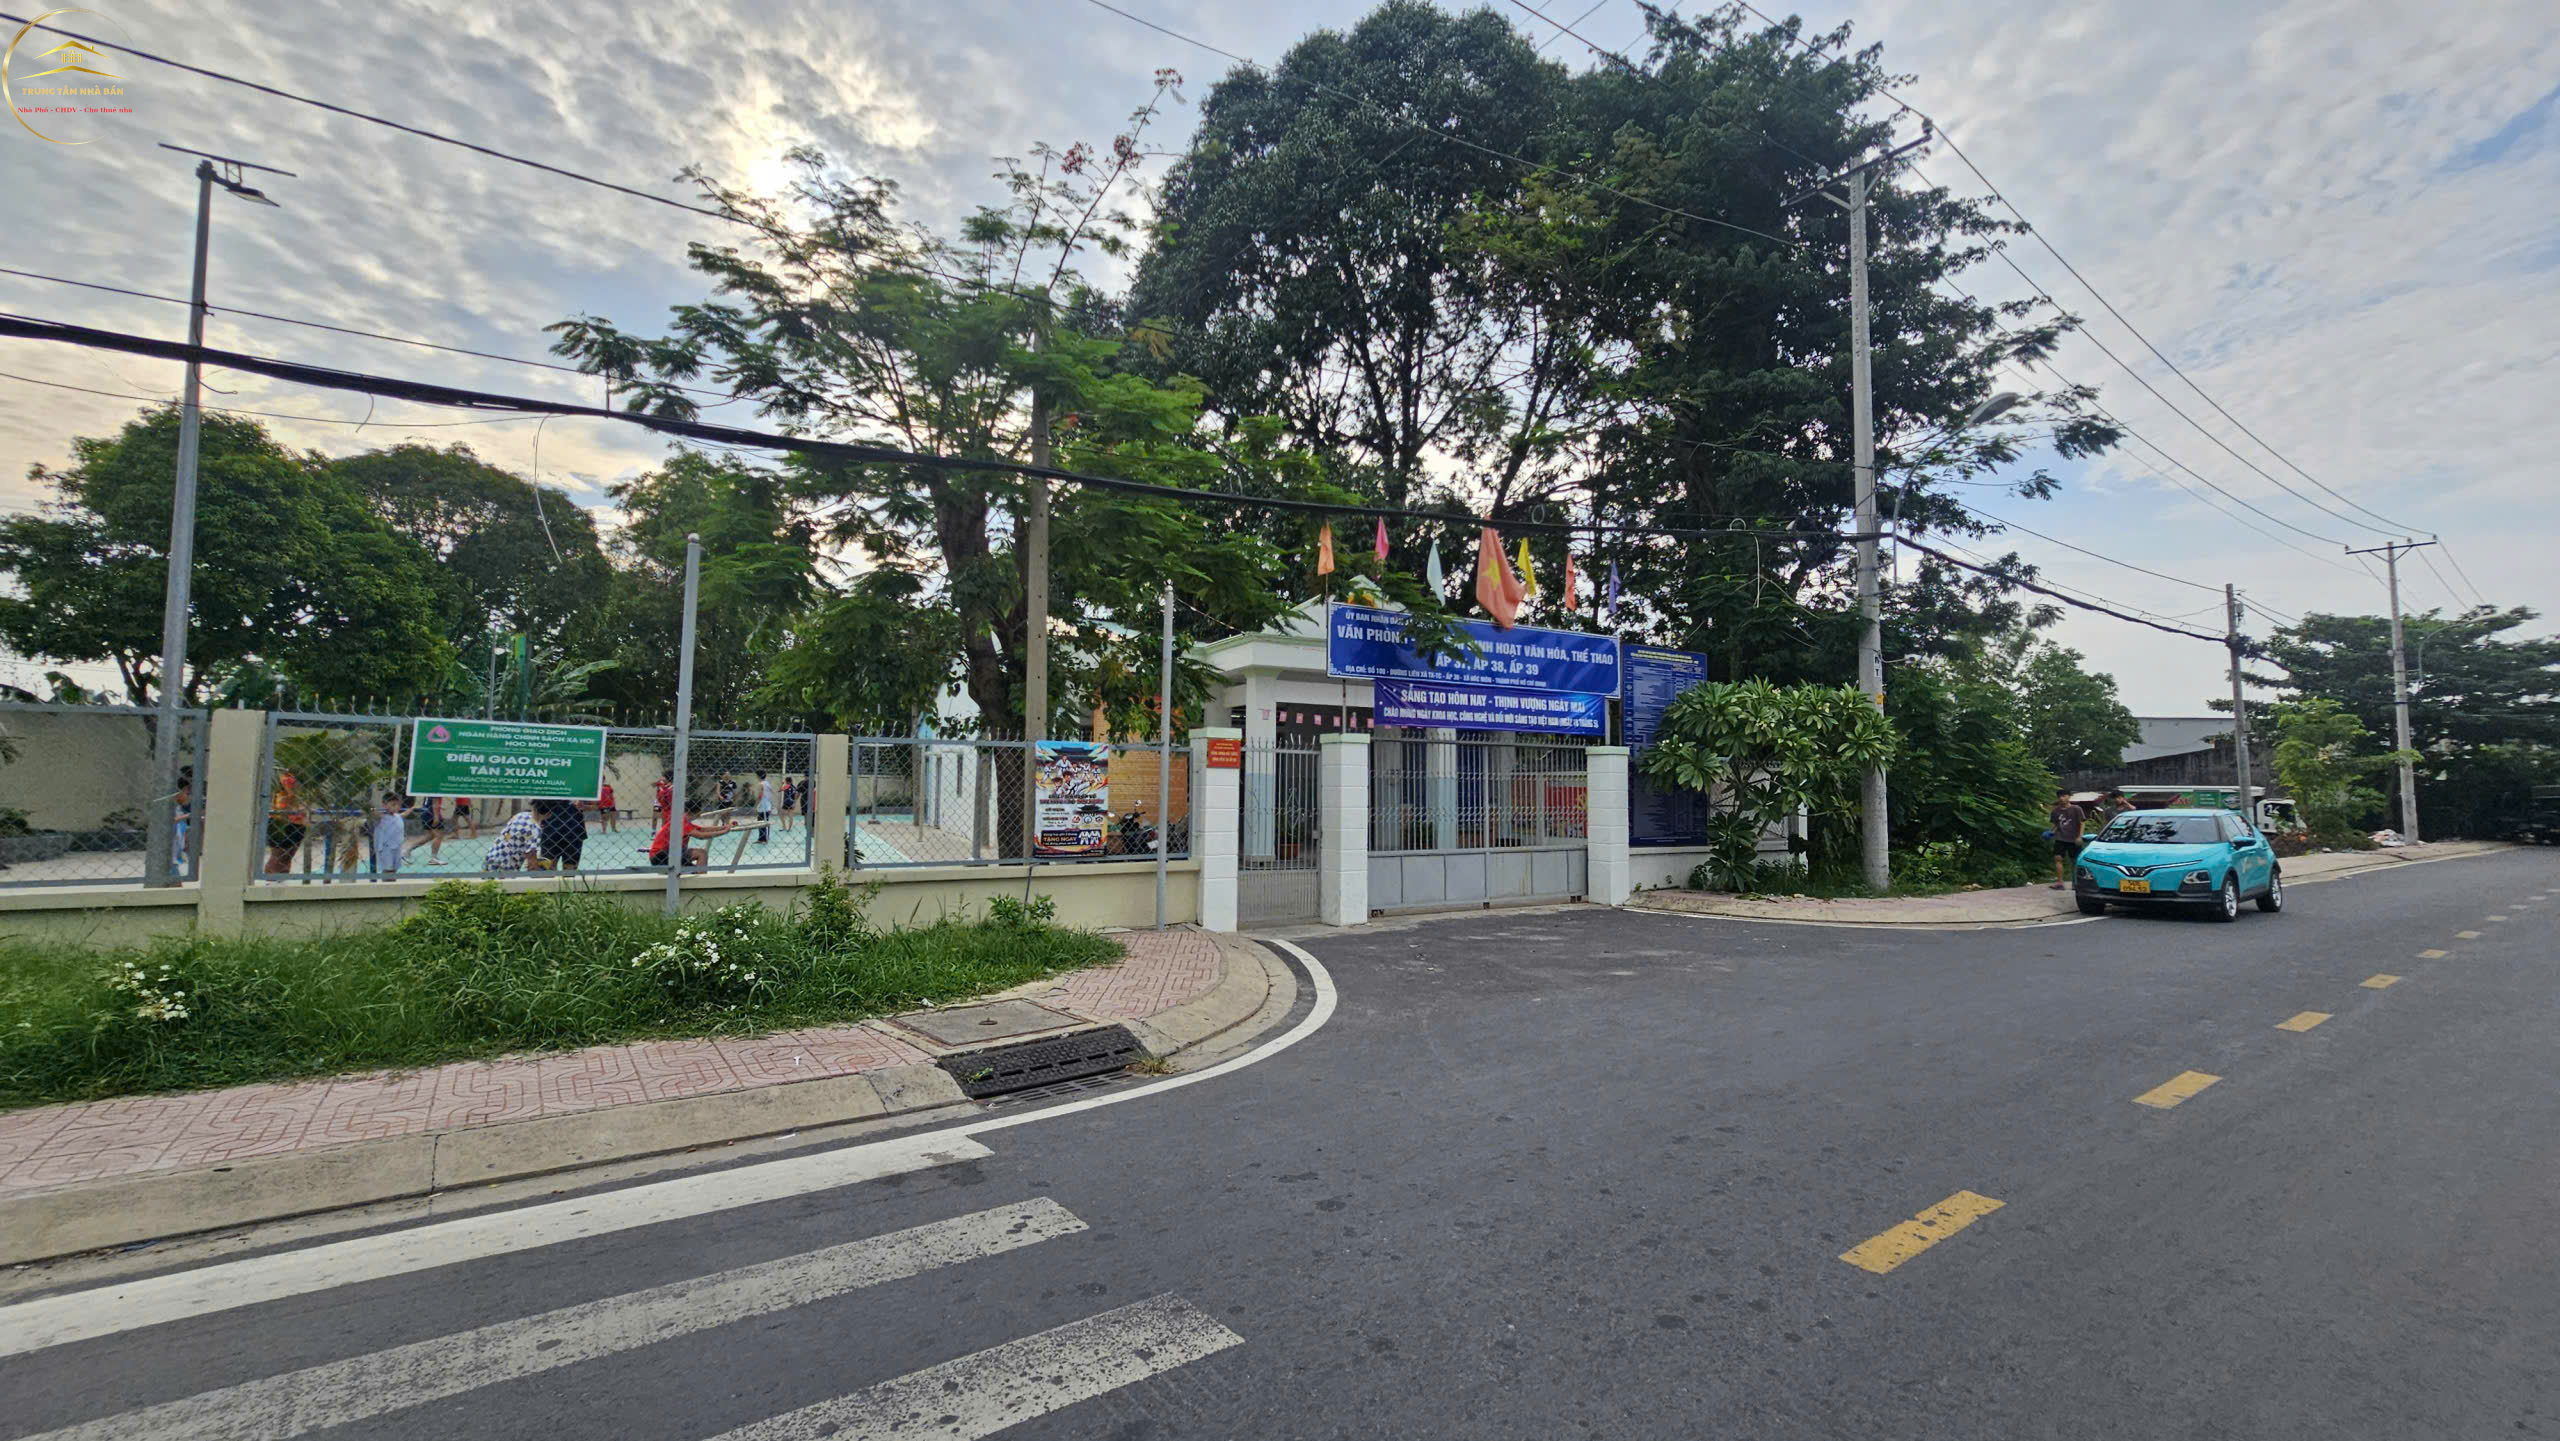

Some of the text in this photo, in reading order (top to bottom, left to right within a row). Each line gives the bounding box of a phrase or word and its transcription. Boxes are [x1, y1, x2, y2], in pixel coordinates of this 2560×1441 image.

[1355, 612, 1370, 621] BAN
[1371, 614, 1388, 624] NHÂN
[1337, 623, 1363, 640] VĂN
[1495, 641, 1522, 658] HOẠT
[1524, 644, 1545, 659] VĂN
[1546, 646, 1570, 662] HÓA,
[1590, 652, 1614, 665] THAO
[1490, 660, 1507, 674] 38,
[1509, 658, 1524, 674] ẤP
[1525, 663, 1539, 676] 39
[1428, 691, 1446, 706] TẠO
[1448, 691, 1468, 705] HÔM
[1470, 694, 1487, 706] NAY
[1494, 695, 1519, 710] THỊNH
[1520, 697, 1547, 712] VƯỢNG
[1548, 698, 1569, 712] NGÀY
[1570, 701, 1586, 713] MAI
[523, 727, 545, 735] GIAO
[488, 755, 531, 766] GIAO
[534, 757, 572, 768] DỊCH
[470, 766, 548, 778] TÂN XUÂN
[447, 776, 497, 784] TRANSACTION
